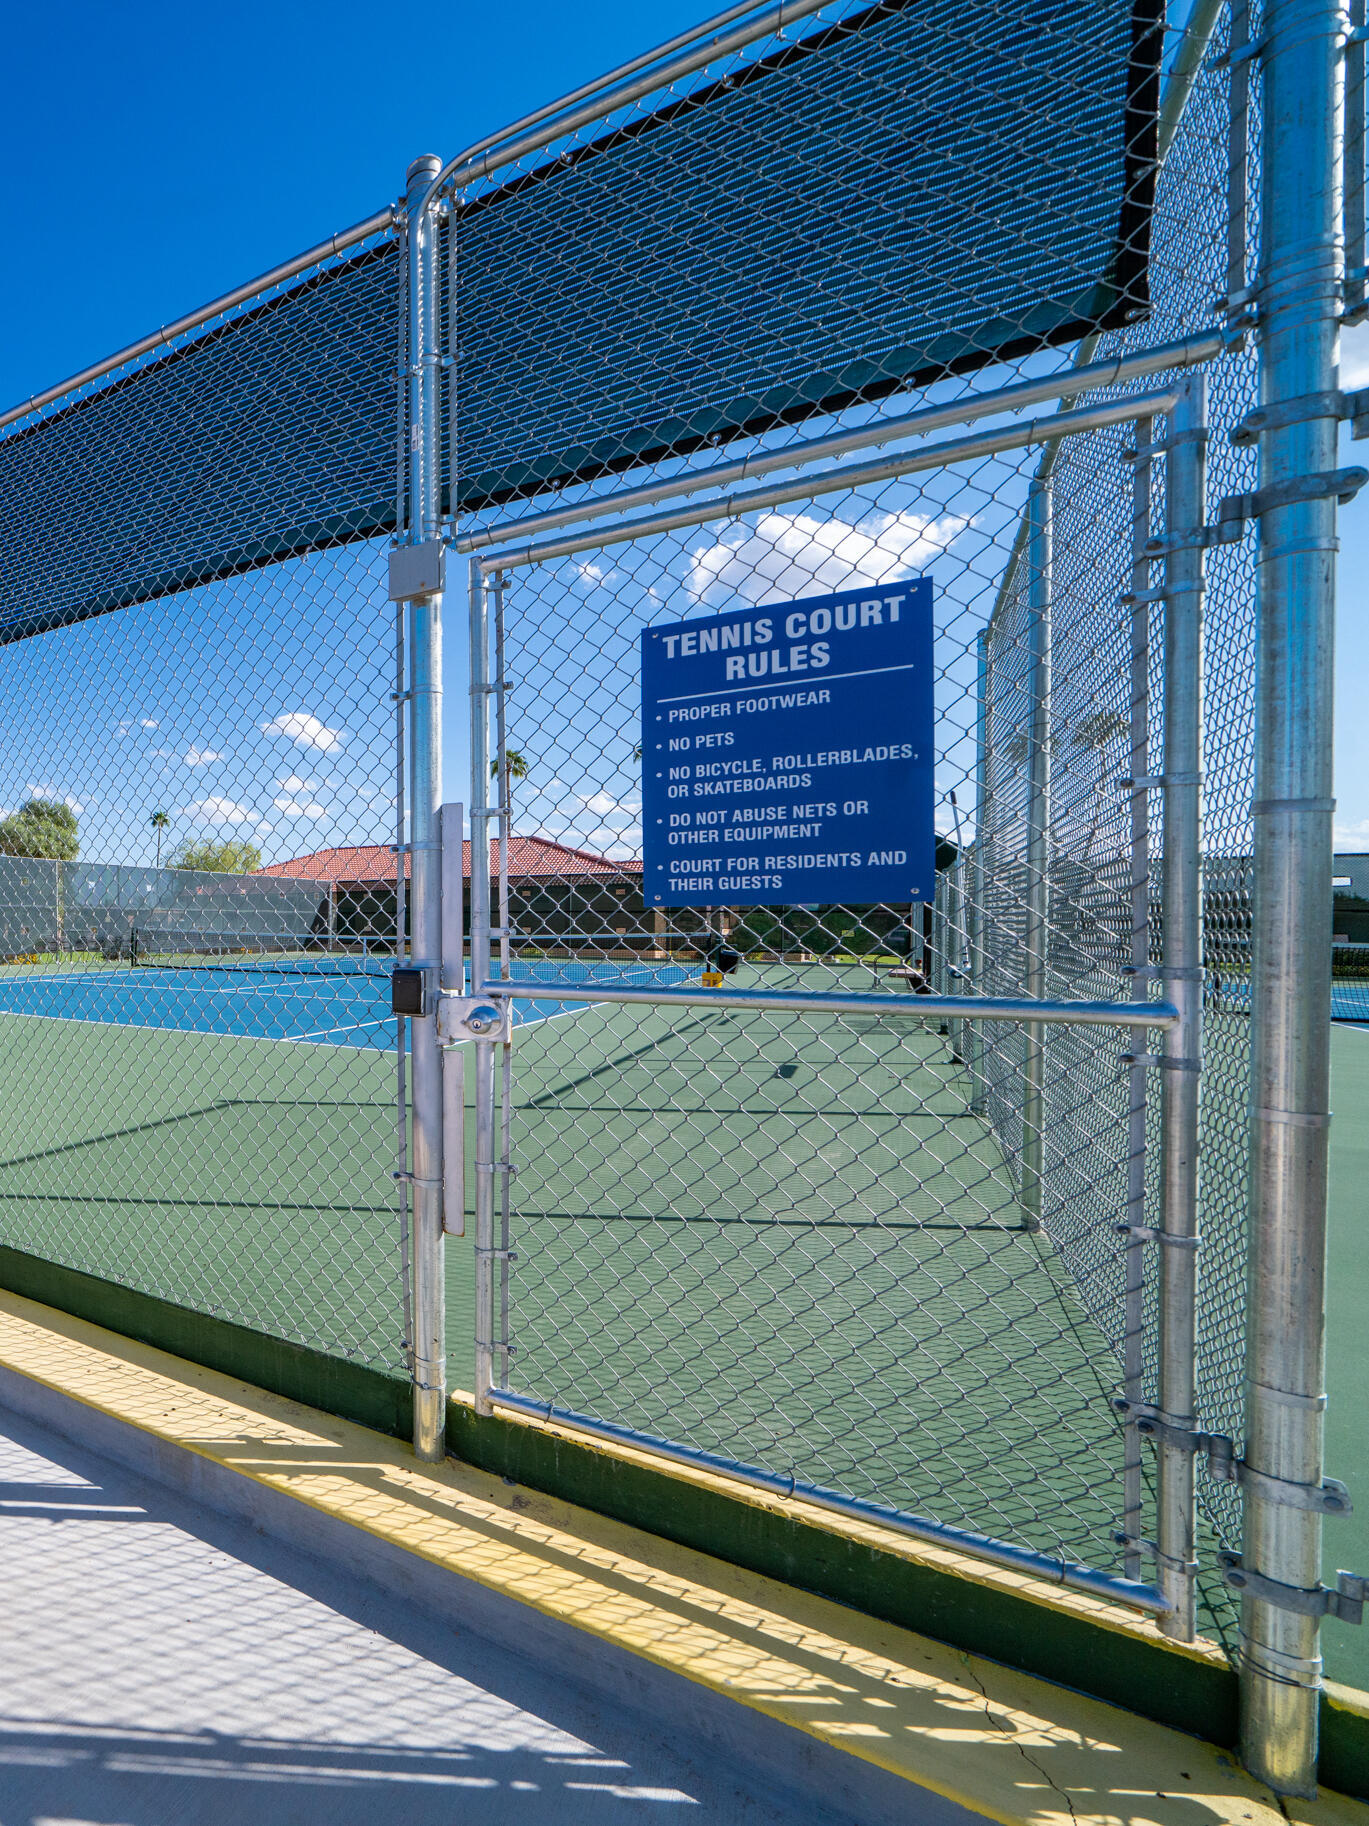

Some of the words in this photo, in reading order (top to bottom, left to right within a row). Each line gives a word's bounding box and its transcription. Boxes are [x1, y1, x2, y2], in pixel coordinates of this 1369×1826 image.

[663, 618, 773, 659] TENNIS
[785, 595, 906, 639] COURT
[726, 641, 831, 680] RULES
[669, 703, 731, 722] PROPER
[736, 690, 831, 714] FOOTWEAR
[669, 736, 691, 752] NO
[696, 732, 735, 748] PETS
[669, 765, 691, 780] NO
[696, 758, 767, 778] BICYCLE,
[772, 744, 919, 771] ROLLERBLADES,
[668, 784, 689, 799] OR
[694, 773, 812, 796] SKATEBOARDS
[670, 812, 691, 827] DO
[696, 810, 728, 825] NOT
[732, 806, 787, 823] ABUSE
[792, 803, 837, 819] NETS
[843, 800, 869, 815] OR
[668, 829, 719, 845] OTHER
[724, 823, 822, 843] EQUIPMENT
[670, 859, 722, 874] COURT
[727, 857, 759, 871] FOR
[764, 853, 861, 870] RESIDENTS
[868, 850, 907, 866] AND
[669, 877, 714, 892] THEIR
[718, 875, 783, 890] GUESTS
